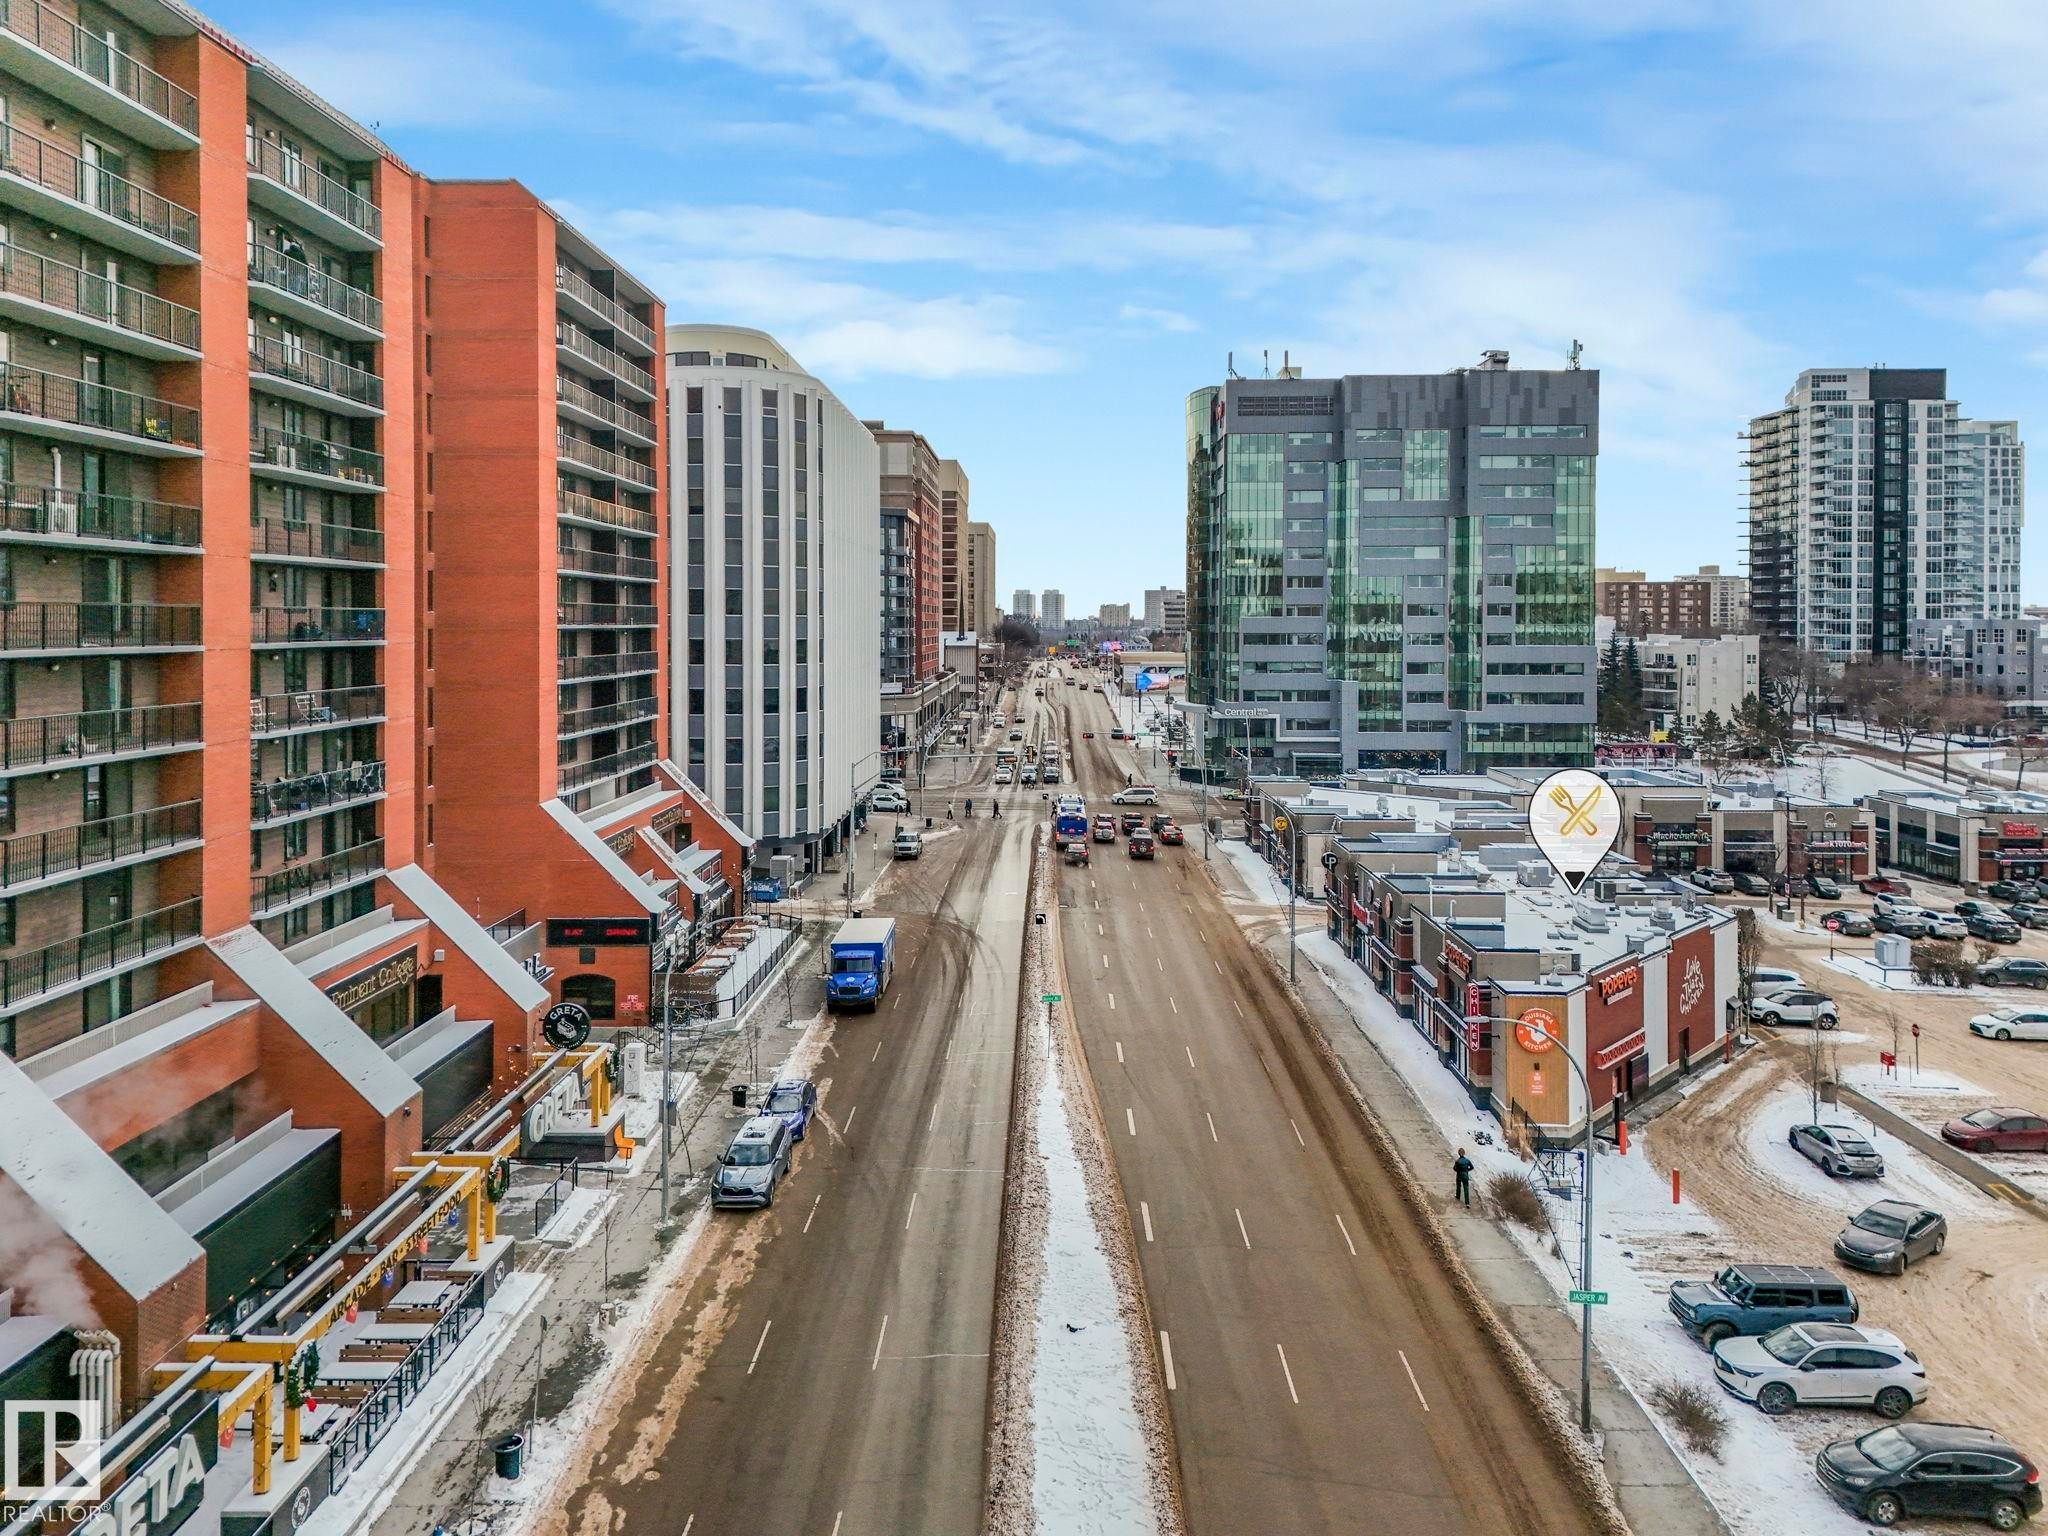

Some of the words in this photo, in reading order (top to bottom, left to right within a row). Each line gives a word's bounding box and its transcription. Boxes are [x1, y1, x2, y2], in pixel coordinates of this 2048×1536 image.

[1224, 707, 1257, 716] Central
[378, 956, 415, 986] College
[549, 1006, 583, 1022] GRETA
[1471, 986, 1479, 1050] CHIKEN
[529, 1072, 582, 1143] GRETA
[328, 1279, 373, 1328] ARCADE
[380, 1249, 399, 1275] BAR
[405, 1210, 438, 1253] STREET
[438, 1190, 462, 1218] FOOD
[1572, 1292, 1596, 1302] JASPER
